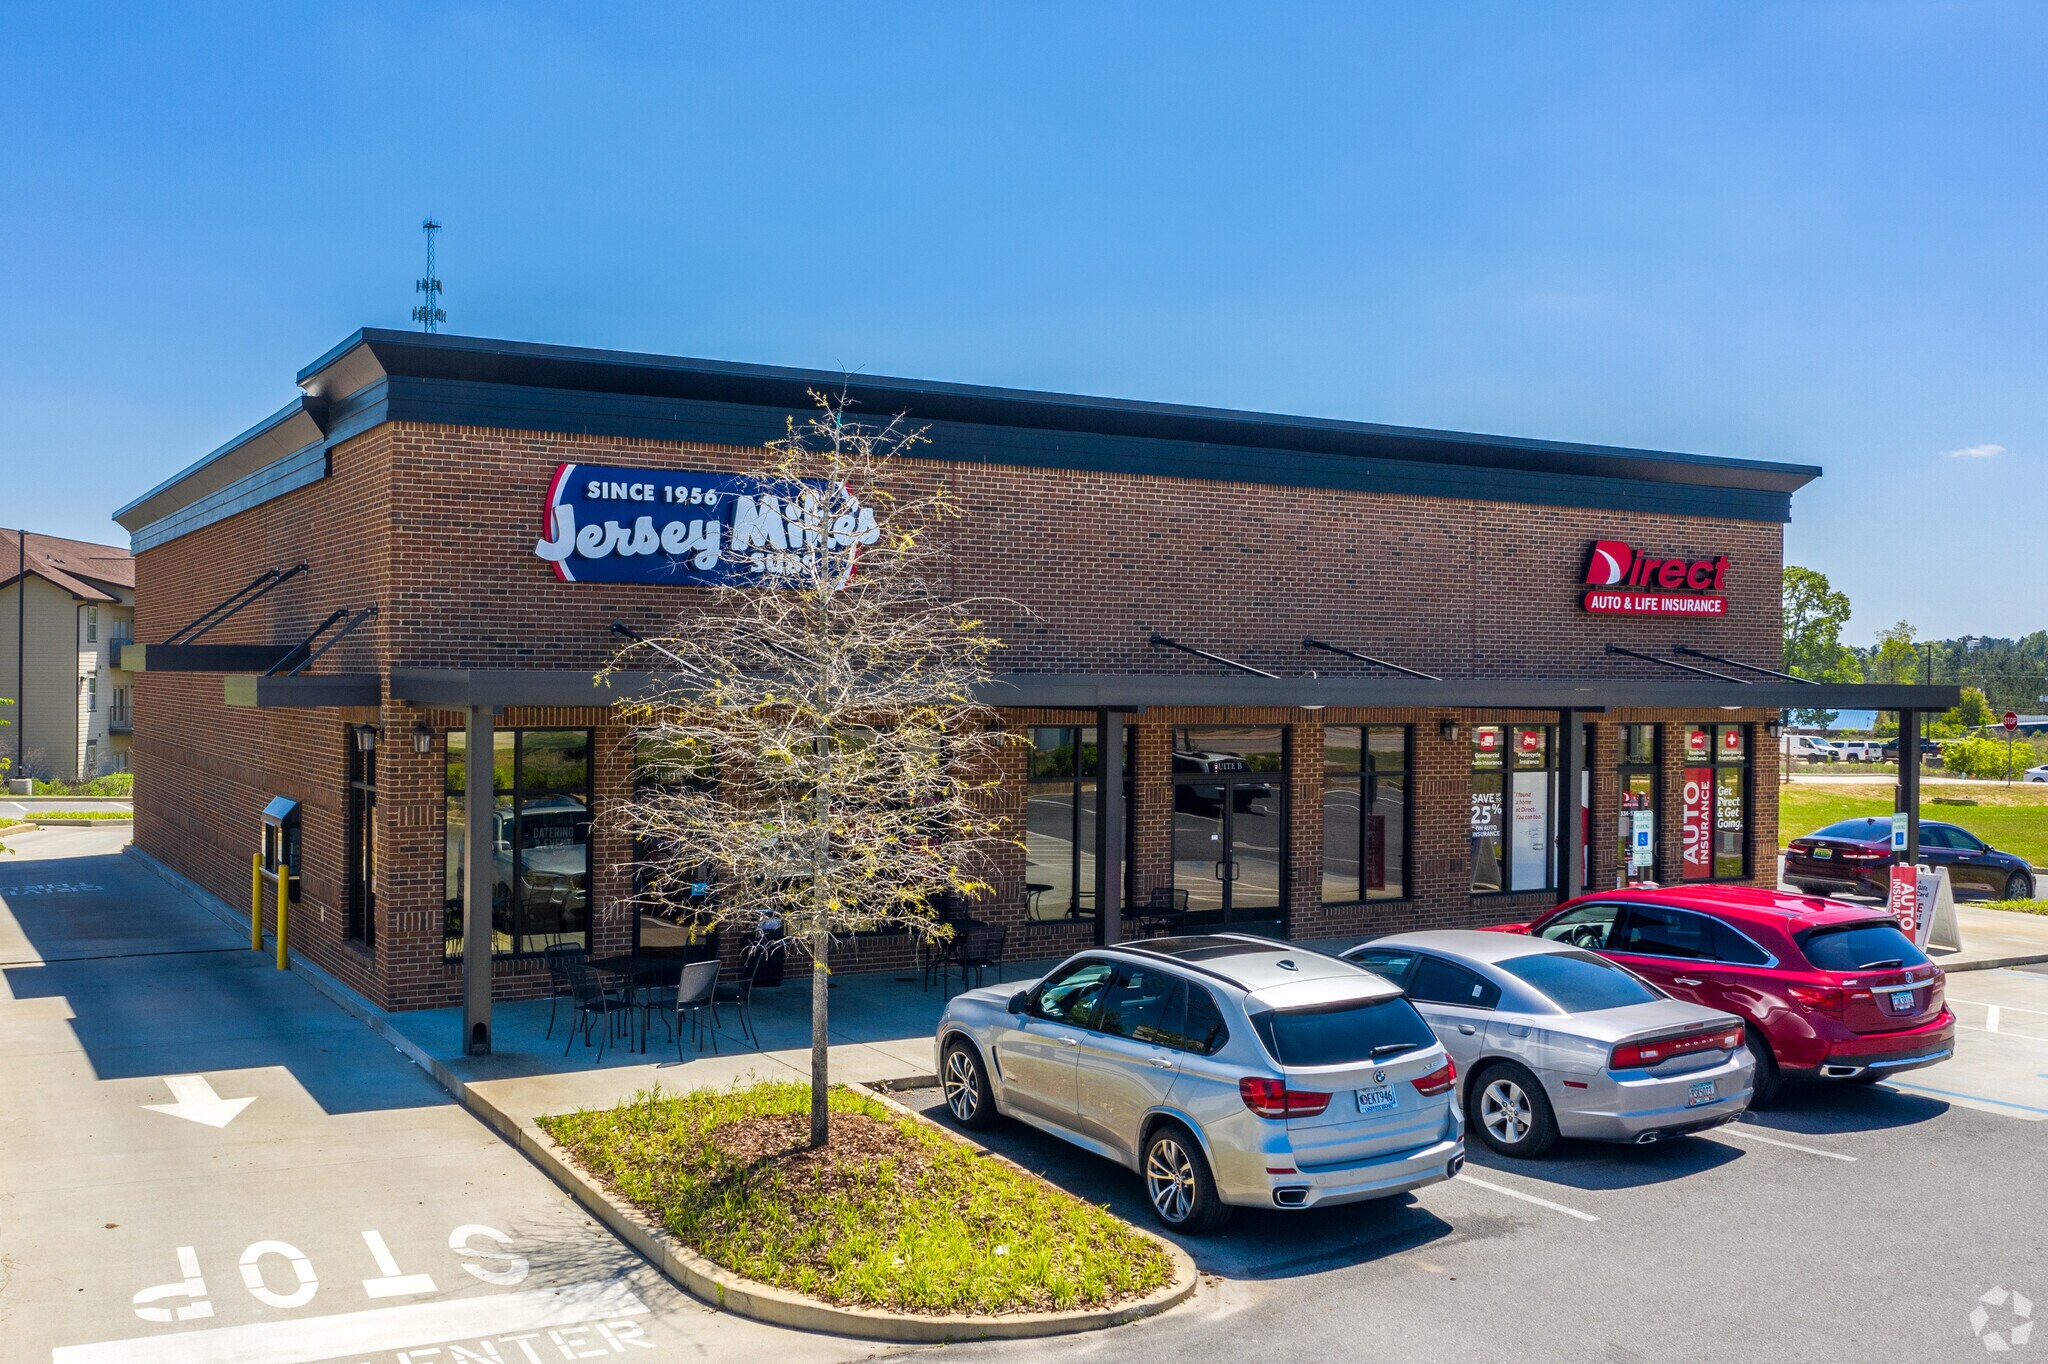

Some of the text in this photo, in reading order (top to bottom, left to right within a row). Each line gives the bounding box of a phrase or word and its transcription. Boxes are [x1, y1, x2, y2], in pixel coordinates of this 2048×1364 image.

[588, 481, 718, 506] SINCE 1956
[535, 503, 722, 570] Jersey
[1586, 540, 1730, 590] Direct
[1591, 596, 1721, 612] AUTO & LIFE INSURANCE
[2004, 717, 2017, 725] STOP
[1237, 762, 1243, 770] B
[1471, 793, 1495, 804] SAVE
[1717, 786, 1732, 796] Get
[1717, 796, 1740, 806] Direct
[1700, 781, 1710, 864] INSURANCE
[1717, 807, 1740, 818] & Get
[1683, 781, 1700, 865] AUTO
[1892, 878, 1901, 921] INSURA
[1900, 882, 1915, 931] AUTO
[1675, 1038, 1714, 1048] DODGE
[133, 1224, 530, 1322] STOP
